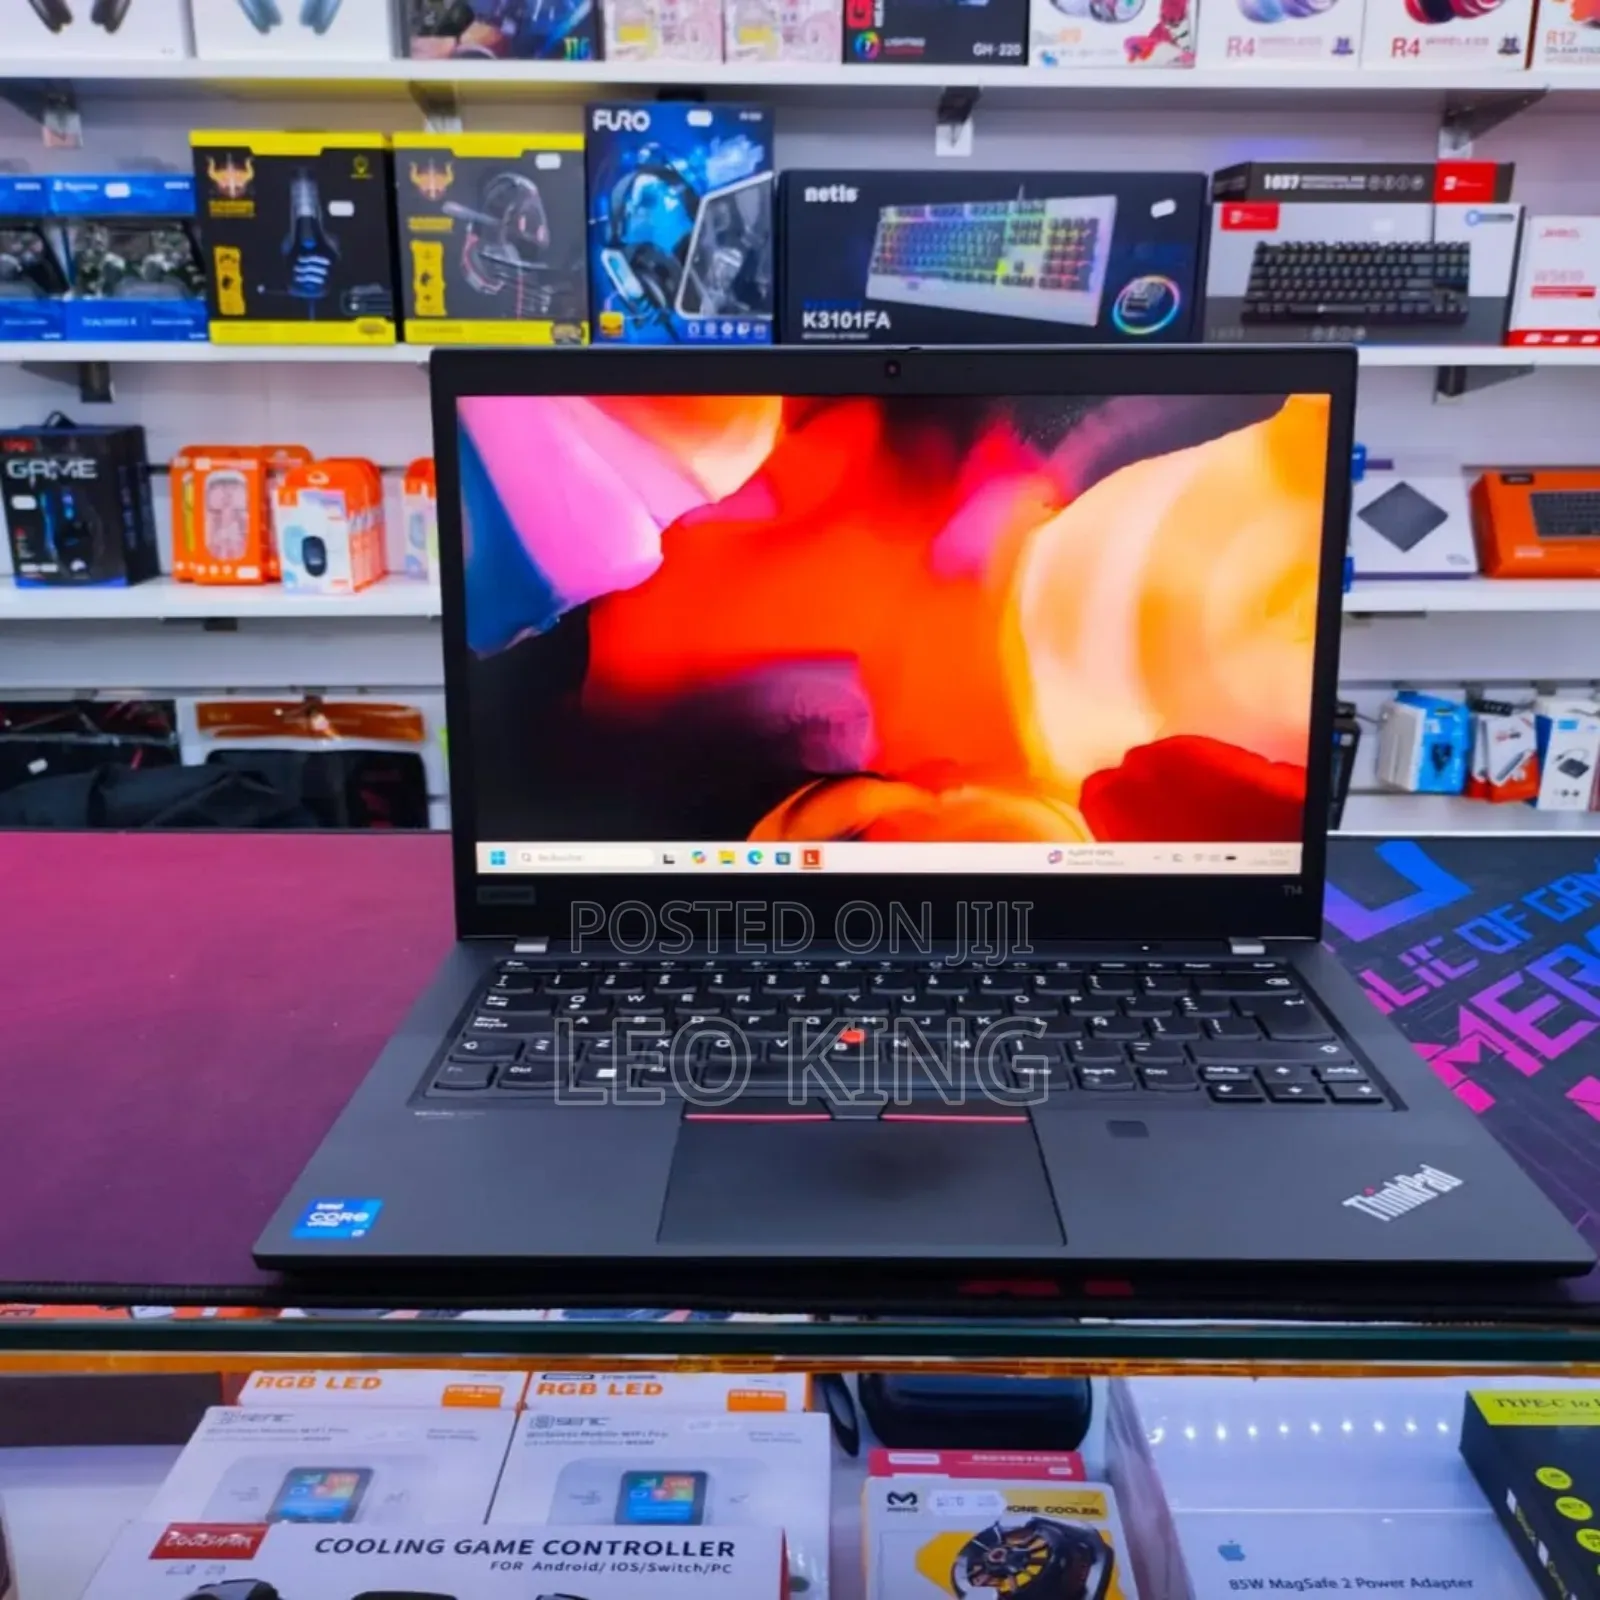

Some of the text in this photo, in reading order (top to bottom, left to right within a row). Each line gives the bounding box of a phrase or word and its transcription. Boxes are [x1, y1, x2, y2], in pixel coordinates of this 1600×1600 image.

[1226, 36, 1256, 58] R4
[1390, 37, 1421, 58] R4
[592, 109, 651, 132] FURO
[804, 184, 859, 203] netis
[803, 310, 892, 329] K3101FA
[6, 459, 98, 479] GAME
[1359, 935, 1480, 1016] LIC
[1452, 903, 1534, 955] OF
[1341, 1162, 1464, 1222] ThinkPad
[254, 1375, 383, 1390] RGB LED
[536, 1382, 664, 1396] RGB LED
[314, 1537, 736, 1559] COOLING GAME CONTROLLER
[490, 1561, 524, 1571] FOR
[532, 1560, 606, 1573] Android/
[1228, 1576, 1475, 1592] 85W MagSafe 2 Power Adapter
